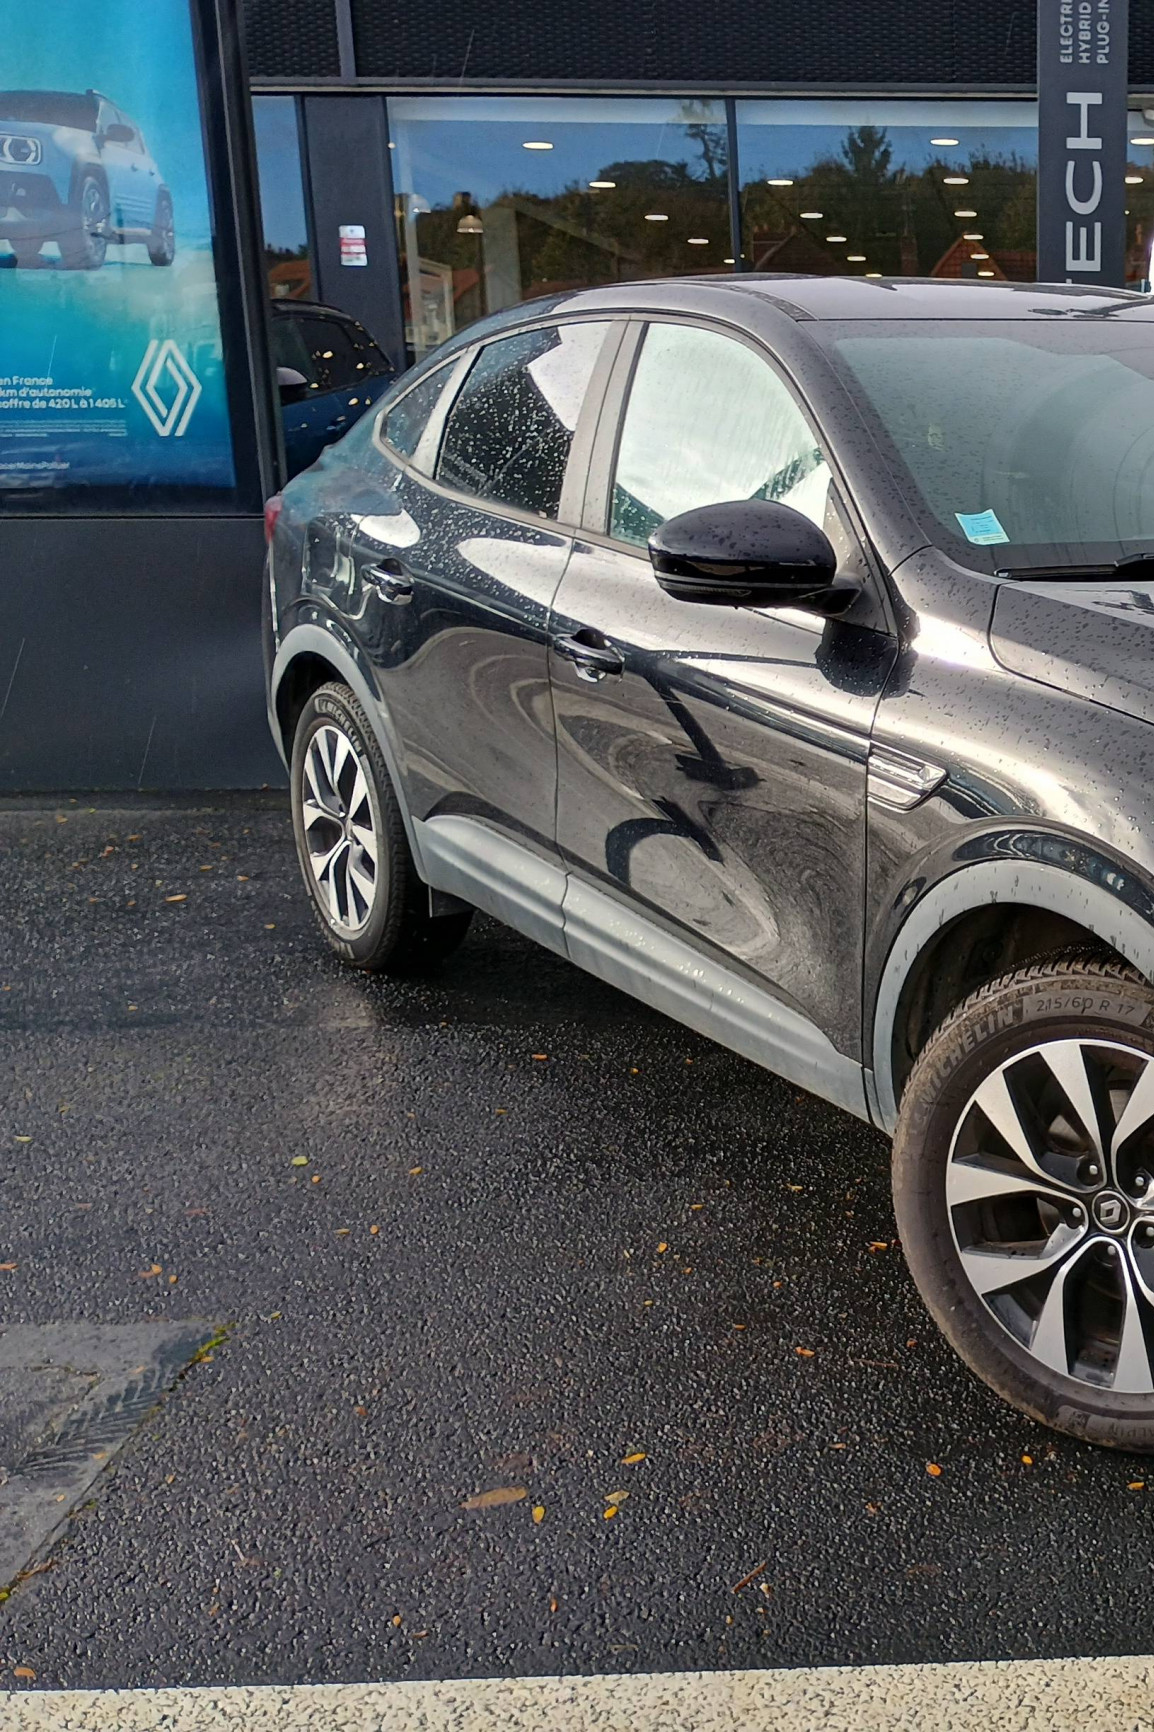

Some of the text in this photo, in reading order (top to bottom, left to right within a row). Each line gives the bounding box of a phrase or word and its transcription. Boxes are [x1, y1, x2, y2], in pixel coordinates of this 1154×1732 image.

[1078, 2, 1092, 64] HYBRID
[1065, 92, 1103, 284] ECH
[12, 375, 53, 386] France
[32, 398, 47, 409] de
[1099, 999, 1111, 1012] R
[1117, 1003, 1136, 1016] 17
